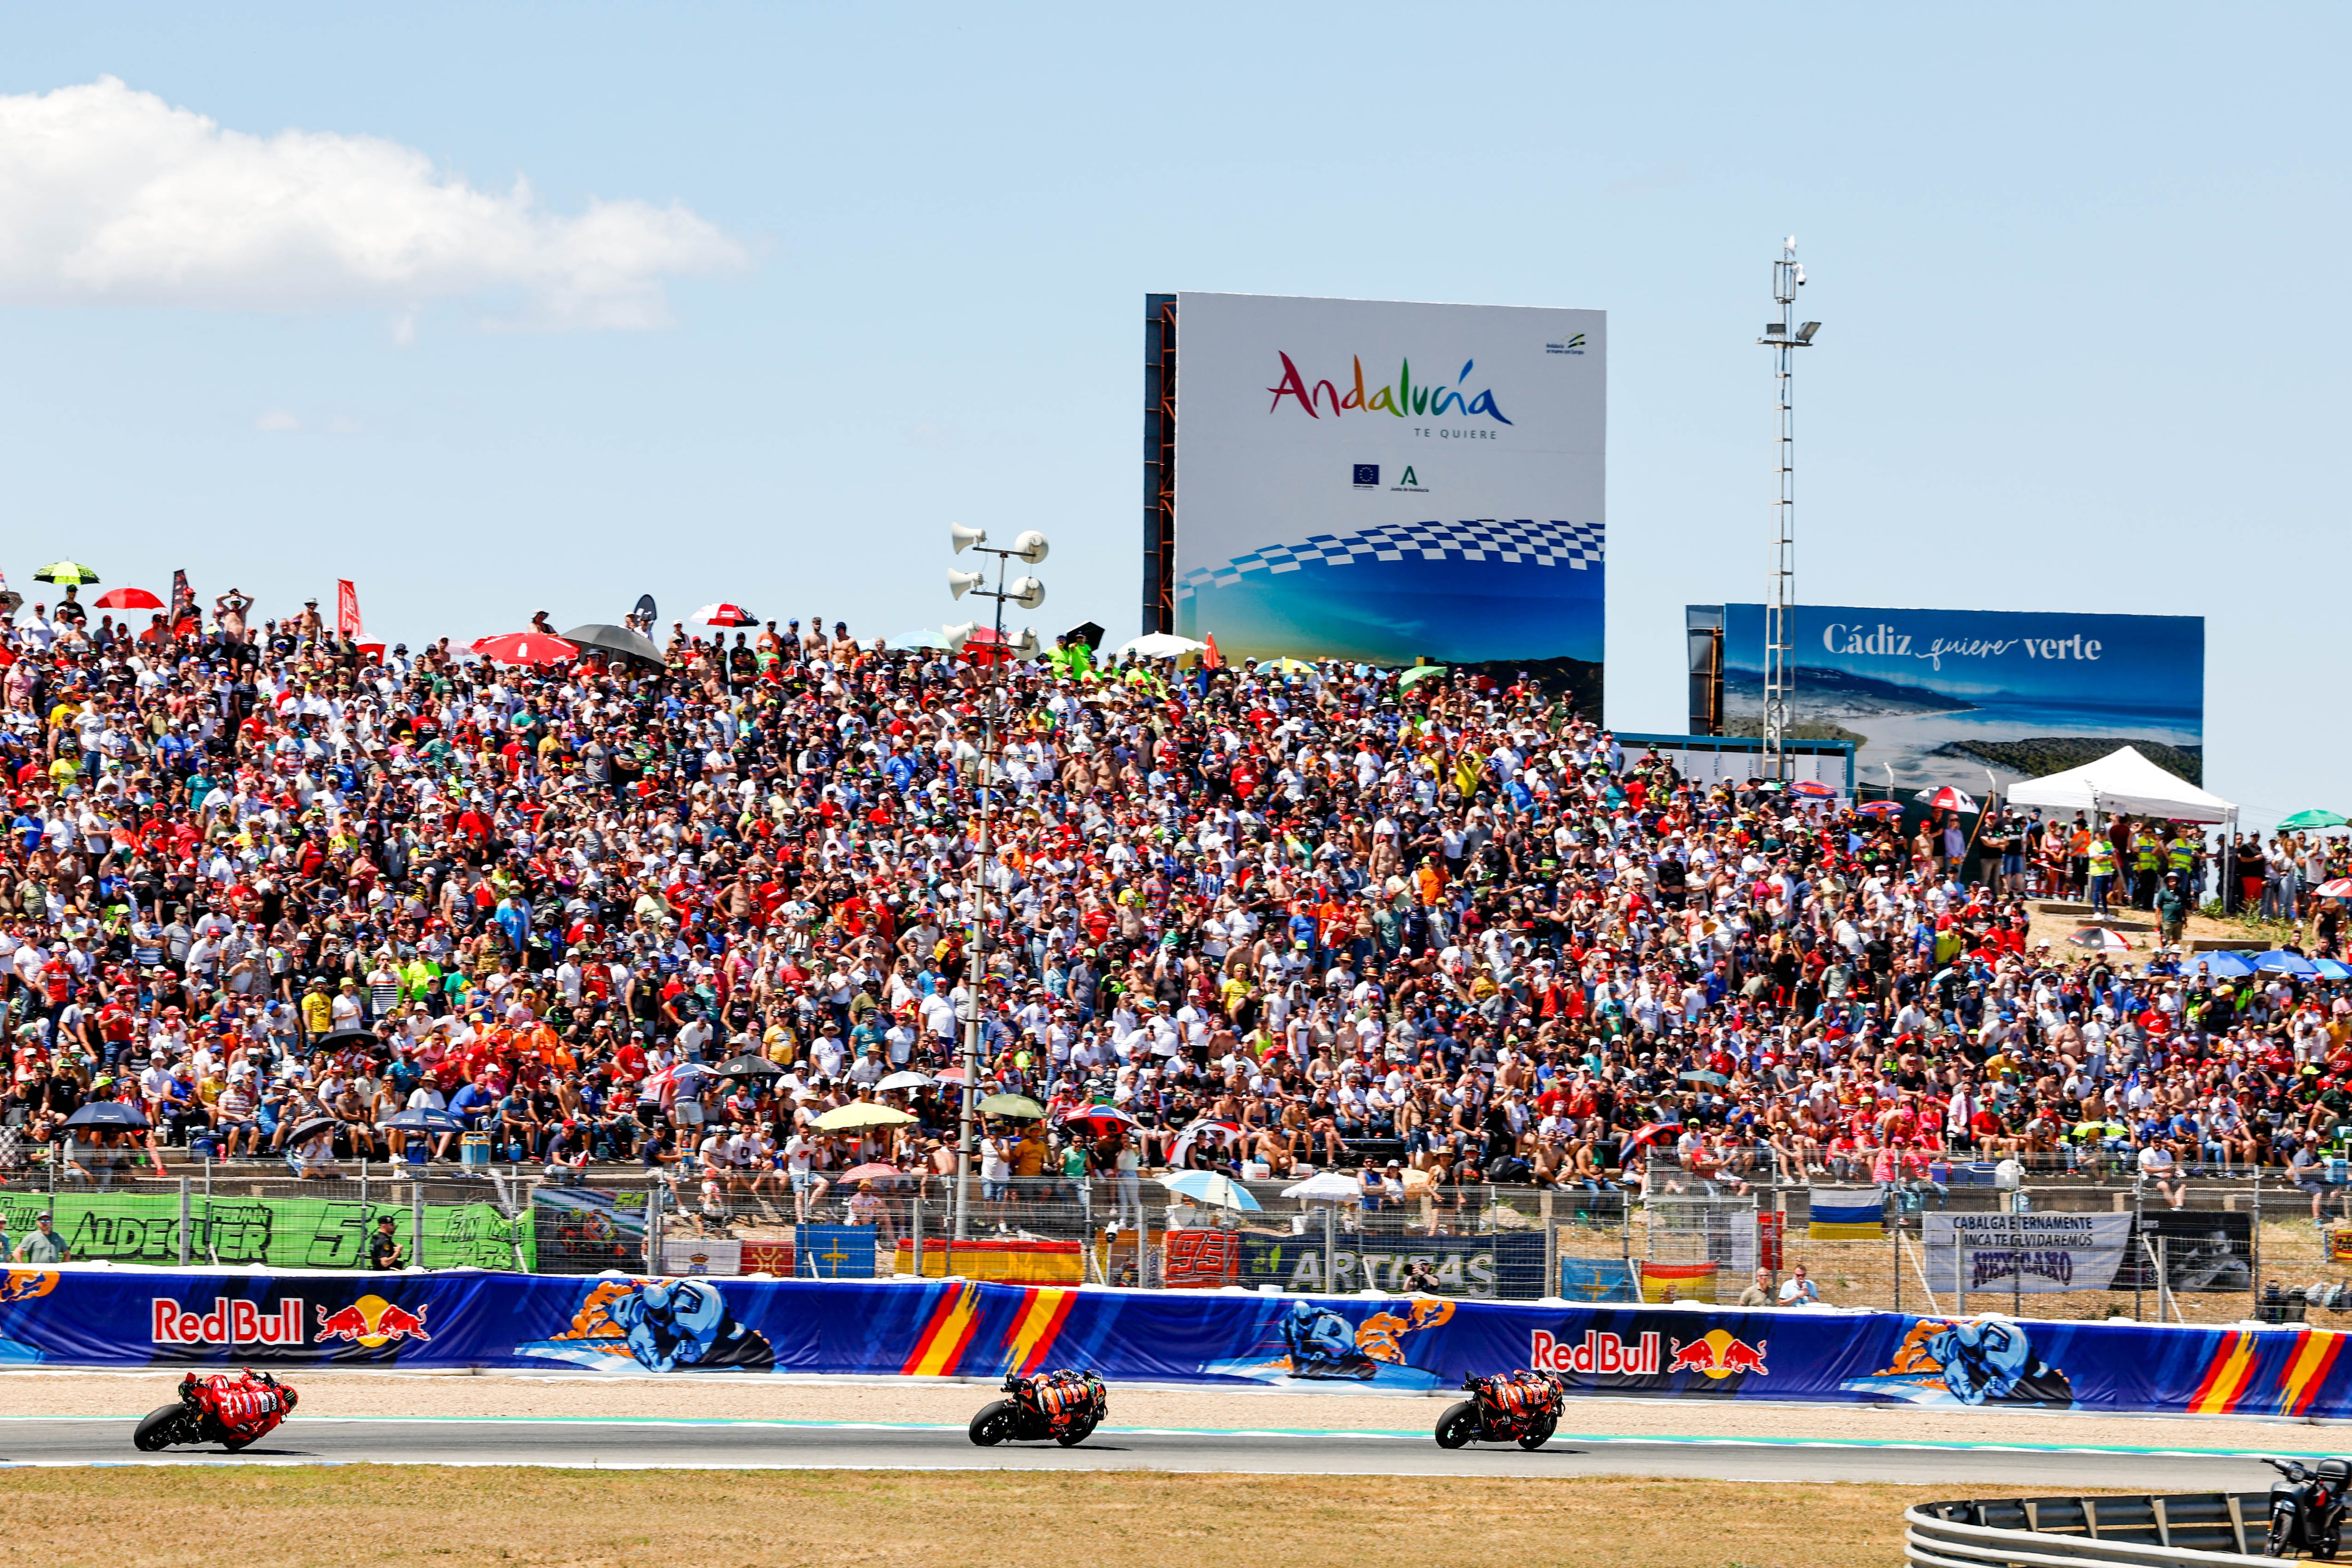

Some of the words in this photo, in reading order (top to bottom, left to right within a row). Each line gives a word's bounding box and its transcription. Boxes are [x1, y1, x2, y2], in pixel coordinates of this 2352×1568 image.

[1266, 350, 1514, 425] Andalucía
[1414, 428, 1430, 437] TE
[1440, 429, 1496, 439] QUIERE
[1823, 623, 1912, 655] Cádiz
[1915, 637, 2018, 671] quiere
[2024, 634, 2102, 661] verte
[613, 1192, 645, 1213] 54
[1954, 1216, 2006, 1229] CABALGA
[2009, 1217, 2092, 1230] EERNAMENTE
[1168, 1233, 1240, 1277] 93
[1953, 1233, 1990, 1246] NCA
[1995, 1234, 2007, 1246] TE
[1287, 1249, 1495, 1298] ARTIAS
[1972, 1251, 2072, 1289] MEXCANO
[151, 1297, 230, 1344] Red
[231, 1297, 304, 1345] Bull
[1531, 1329, 1597, 1373] Red
[1597, 1331, 1661, 1376] Bull
